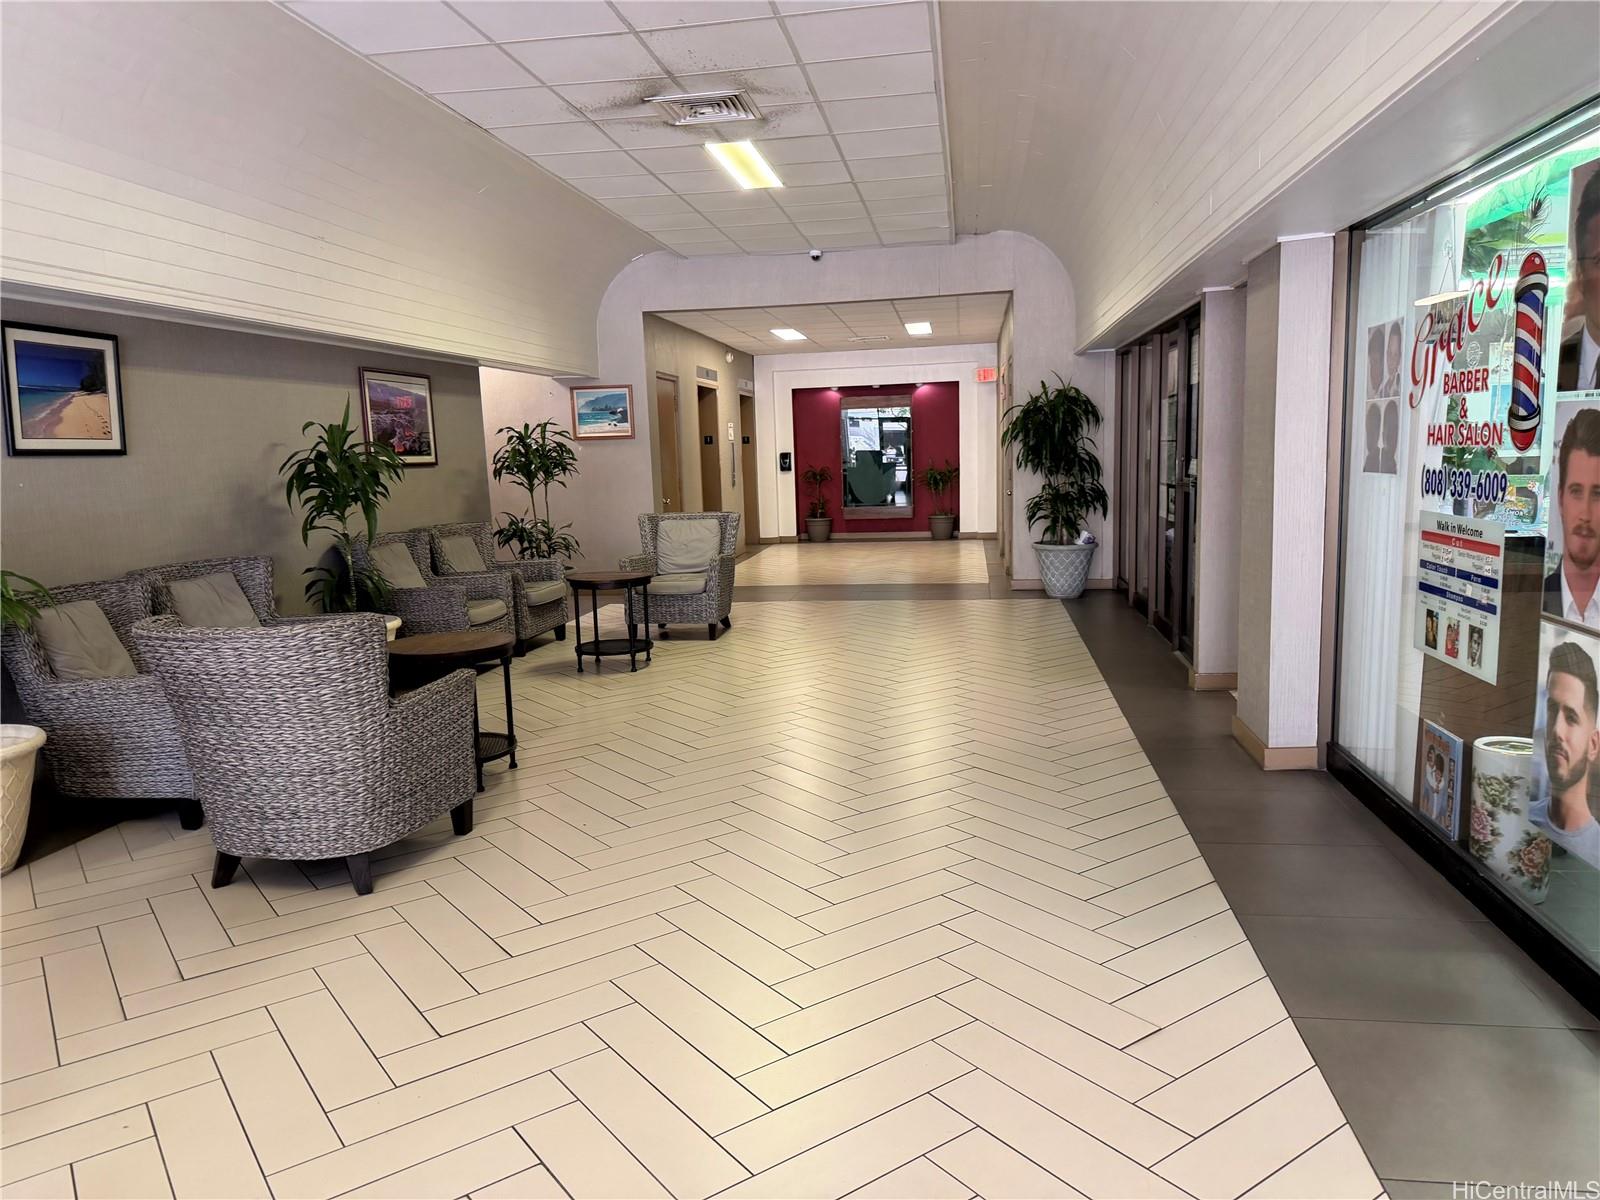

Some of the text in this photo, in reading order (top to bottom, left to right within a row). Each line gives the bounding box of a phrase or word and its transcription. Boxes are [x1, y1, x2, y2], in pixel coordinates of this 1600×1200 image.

[1409, 252, 1511, 408] Grace
[1443, 367, 1490, 395] BARBER
[1459, 397, 1469, 420] &
[1427, 422, 1504, 446] HAIR SALON
[1421, 464, 1508, 503] (808) 339-6009
[1436, 519, 1484, 539] Walk in Welcome
[1451, 537, 1464, 548] Cut
